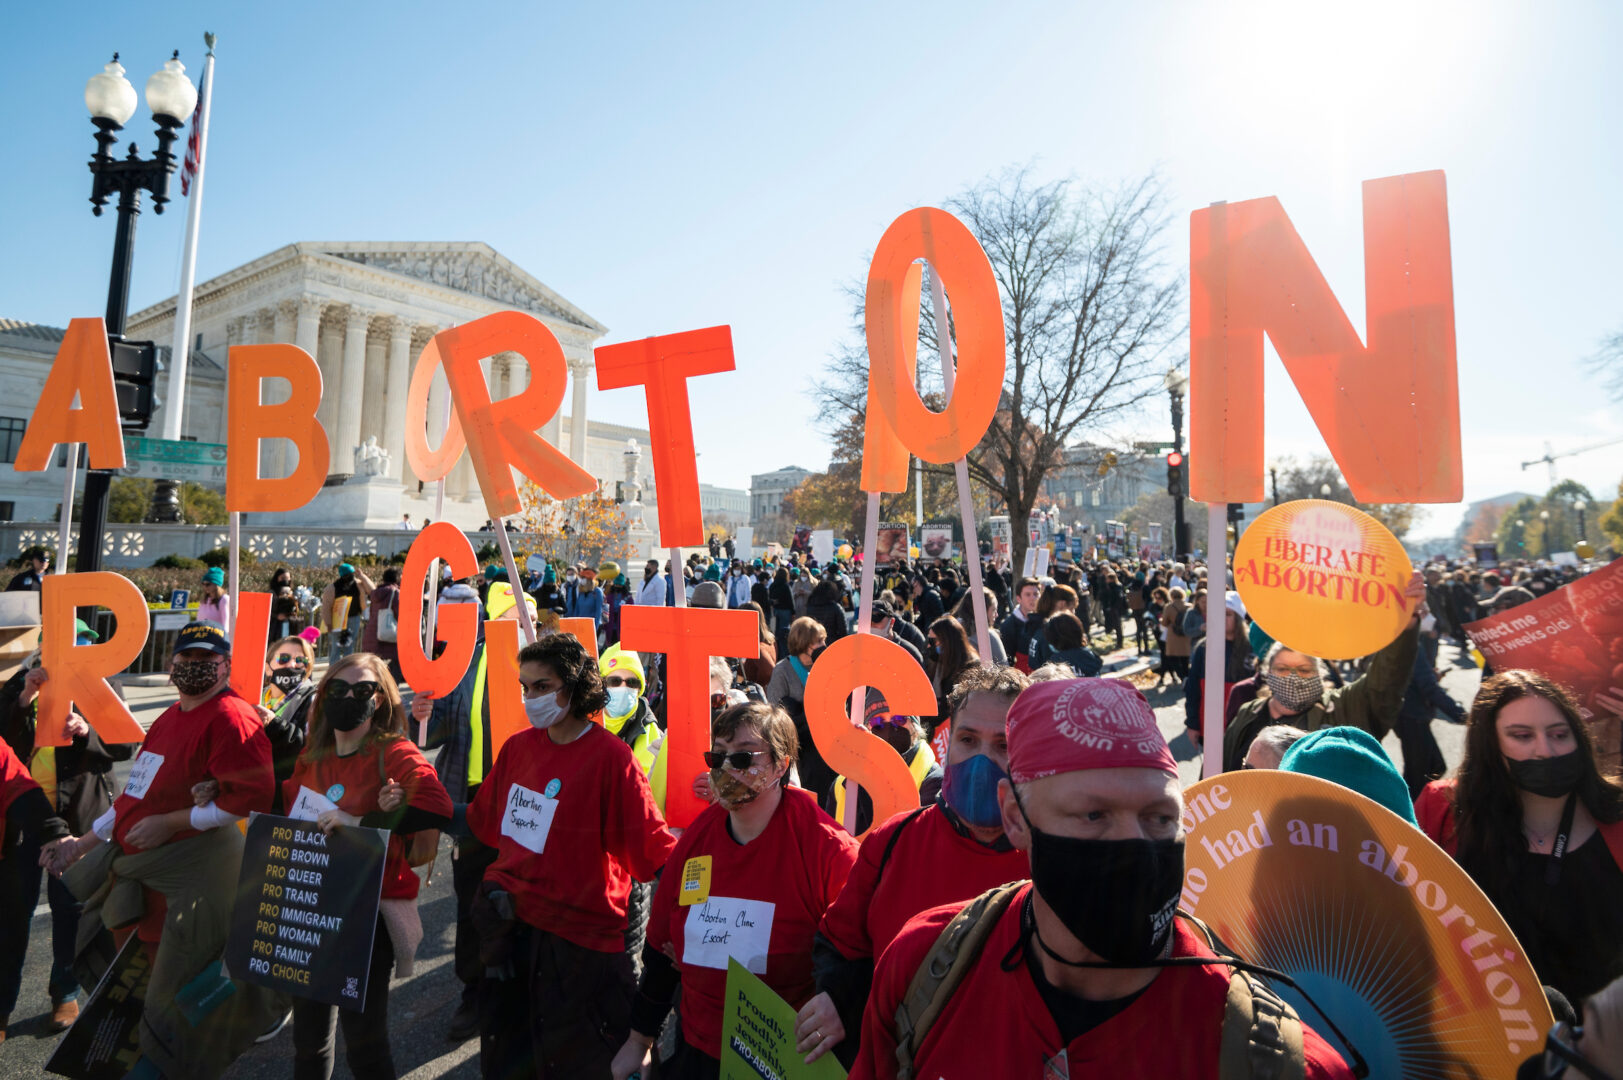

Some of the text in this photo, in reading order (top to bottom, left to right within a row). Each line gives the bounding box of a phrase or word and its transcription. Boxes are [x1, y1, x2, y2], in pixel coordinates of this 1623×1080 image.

[1264, 537, 1386, 577] LIBERATE
[1237, 559, 1407, 612] ABORTION
[182, 625, 224, 638] ABORTION
[1489, 640, 1506, 655] 15
[1504, 628, 1547, 650] weeks
[1546, 617, 1571, 635] old
[1510, 614, 1538, 631] me
[1056, 720, 1113, 751] UNION
[511, 787, 542, 814] Abortion
[511, 809, 539, 830] Supporter
[272, 826, 328, 846] PRO BLACK
[269, 845, 330, 866] PRO BROWN
[266, 864, 322, 886] PRO QUEER
[262, 883, 318, 905] PRO TRANS
[259, 902, 343, 932] PRO IMMIGRANT
[256, 920, 321, 946] PRO WOMAN
[702, 929, 731, 944] Escort
[1200, 809, 1274, 870] had
[1286, 819, 1339, 852] an
[1358, 839, 1540, 1055] abortion.
[253, 939, 312, 965] PRO FAMILY
[249, 957, 311, 984] PRO CHOICE
[737, 1006, 778, 1053] Loudly,
[739, 989, 787, 1044] Proudly,
[734, 1036, 781, 1080] PRO-ABOR
